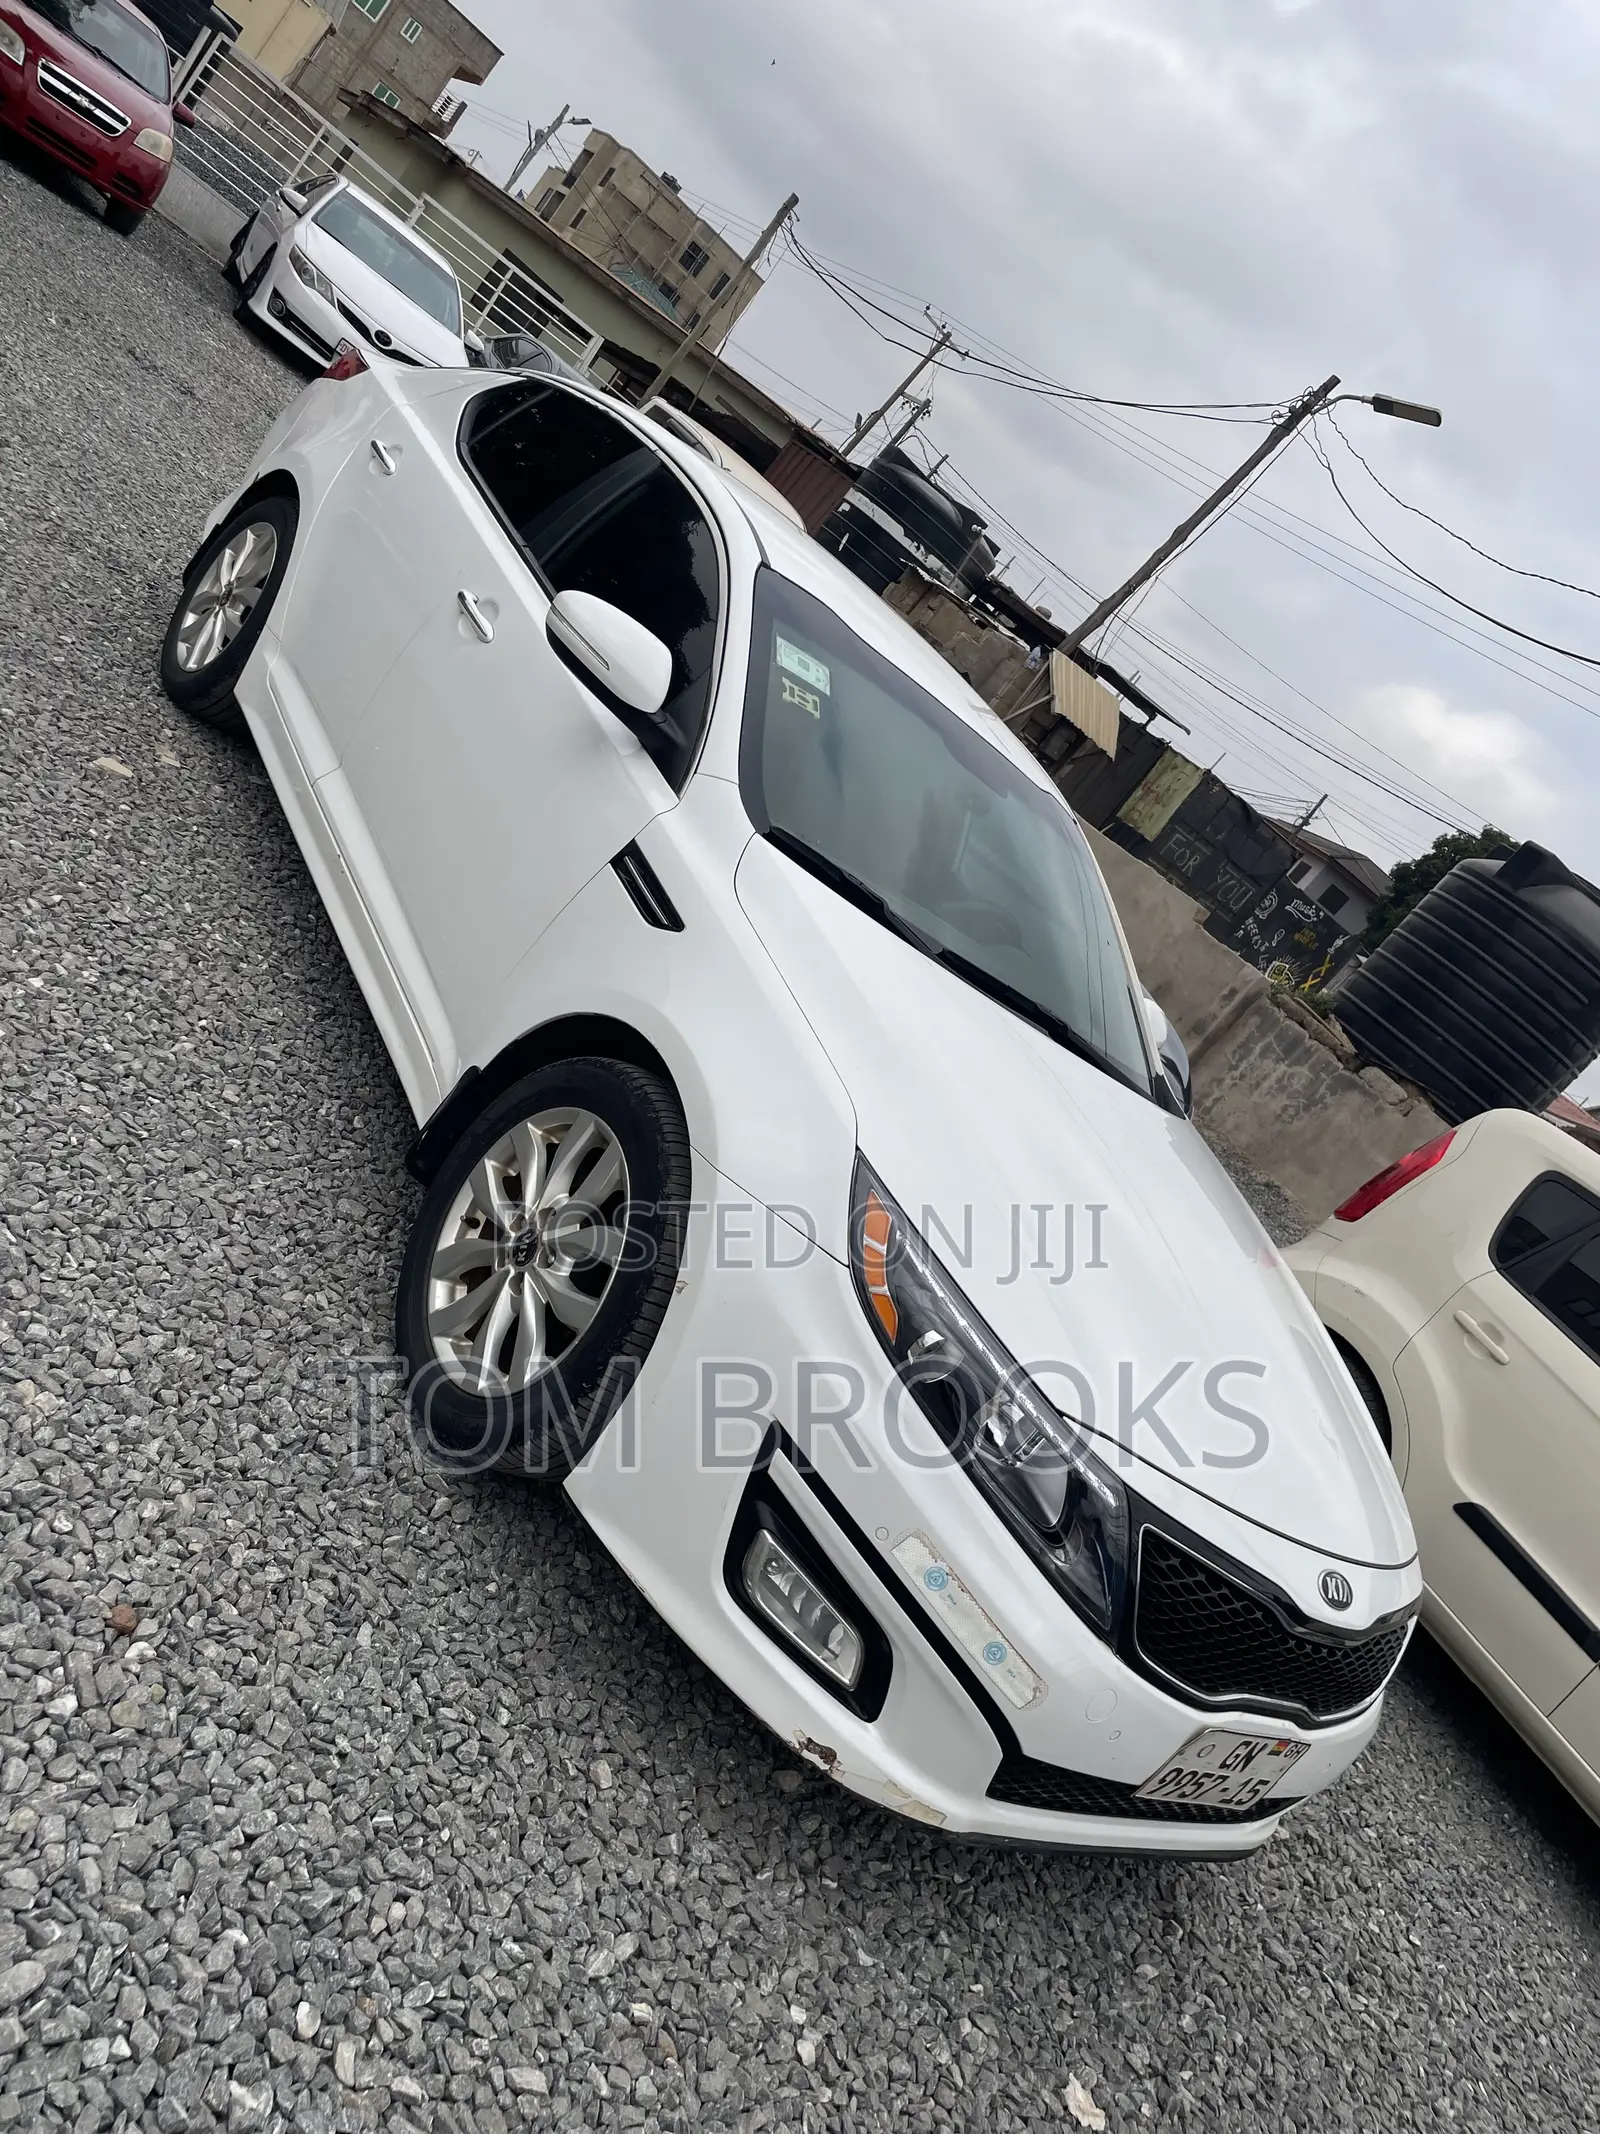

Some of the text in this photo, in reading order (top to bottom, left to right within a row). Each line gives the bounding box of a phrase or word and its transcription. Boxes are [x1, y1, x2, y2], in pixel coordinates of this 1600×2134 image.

[1160, 833, 1201, 877] FOR
[1206, 869, 1253, 912] YOU
[1325, 1576, 1351, 1604] KIA
[1219, 1740, 1307, 1772] GN GH
[1147, 1767, 1271, 1806] 9957-15
